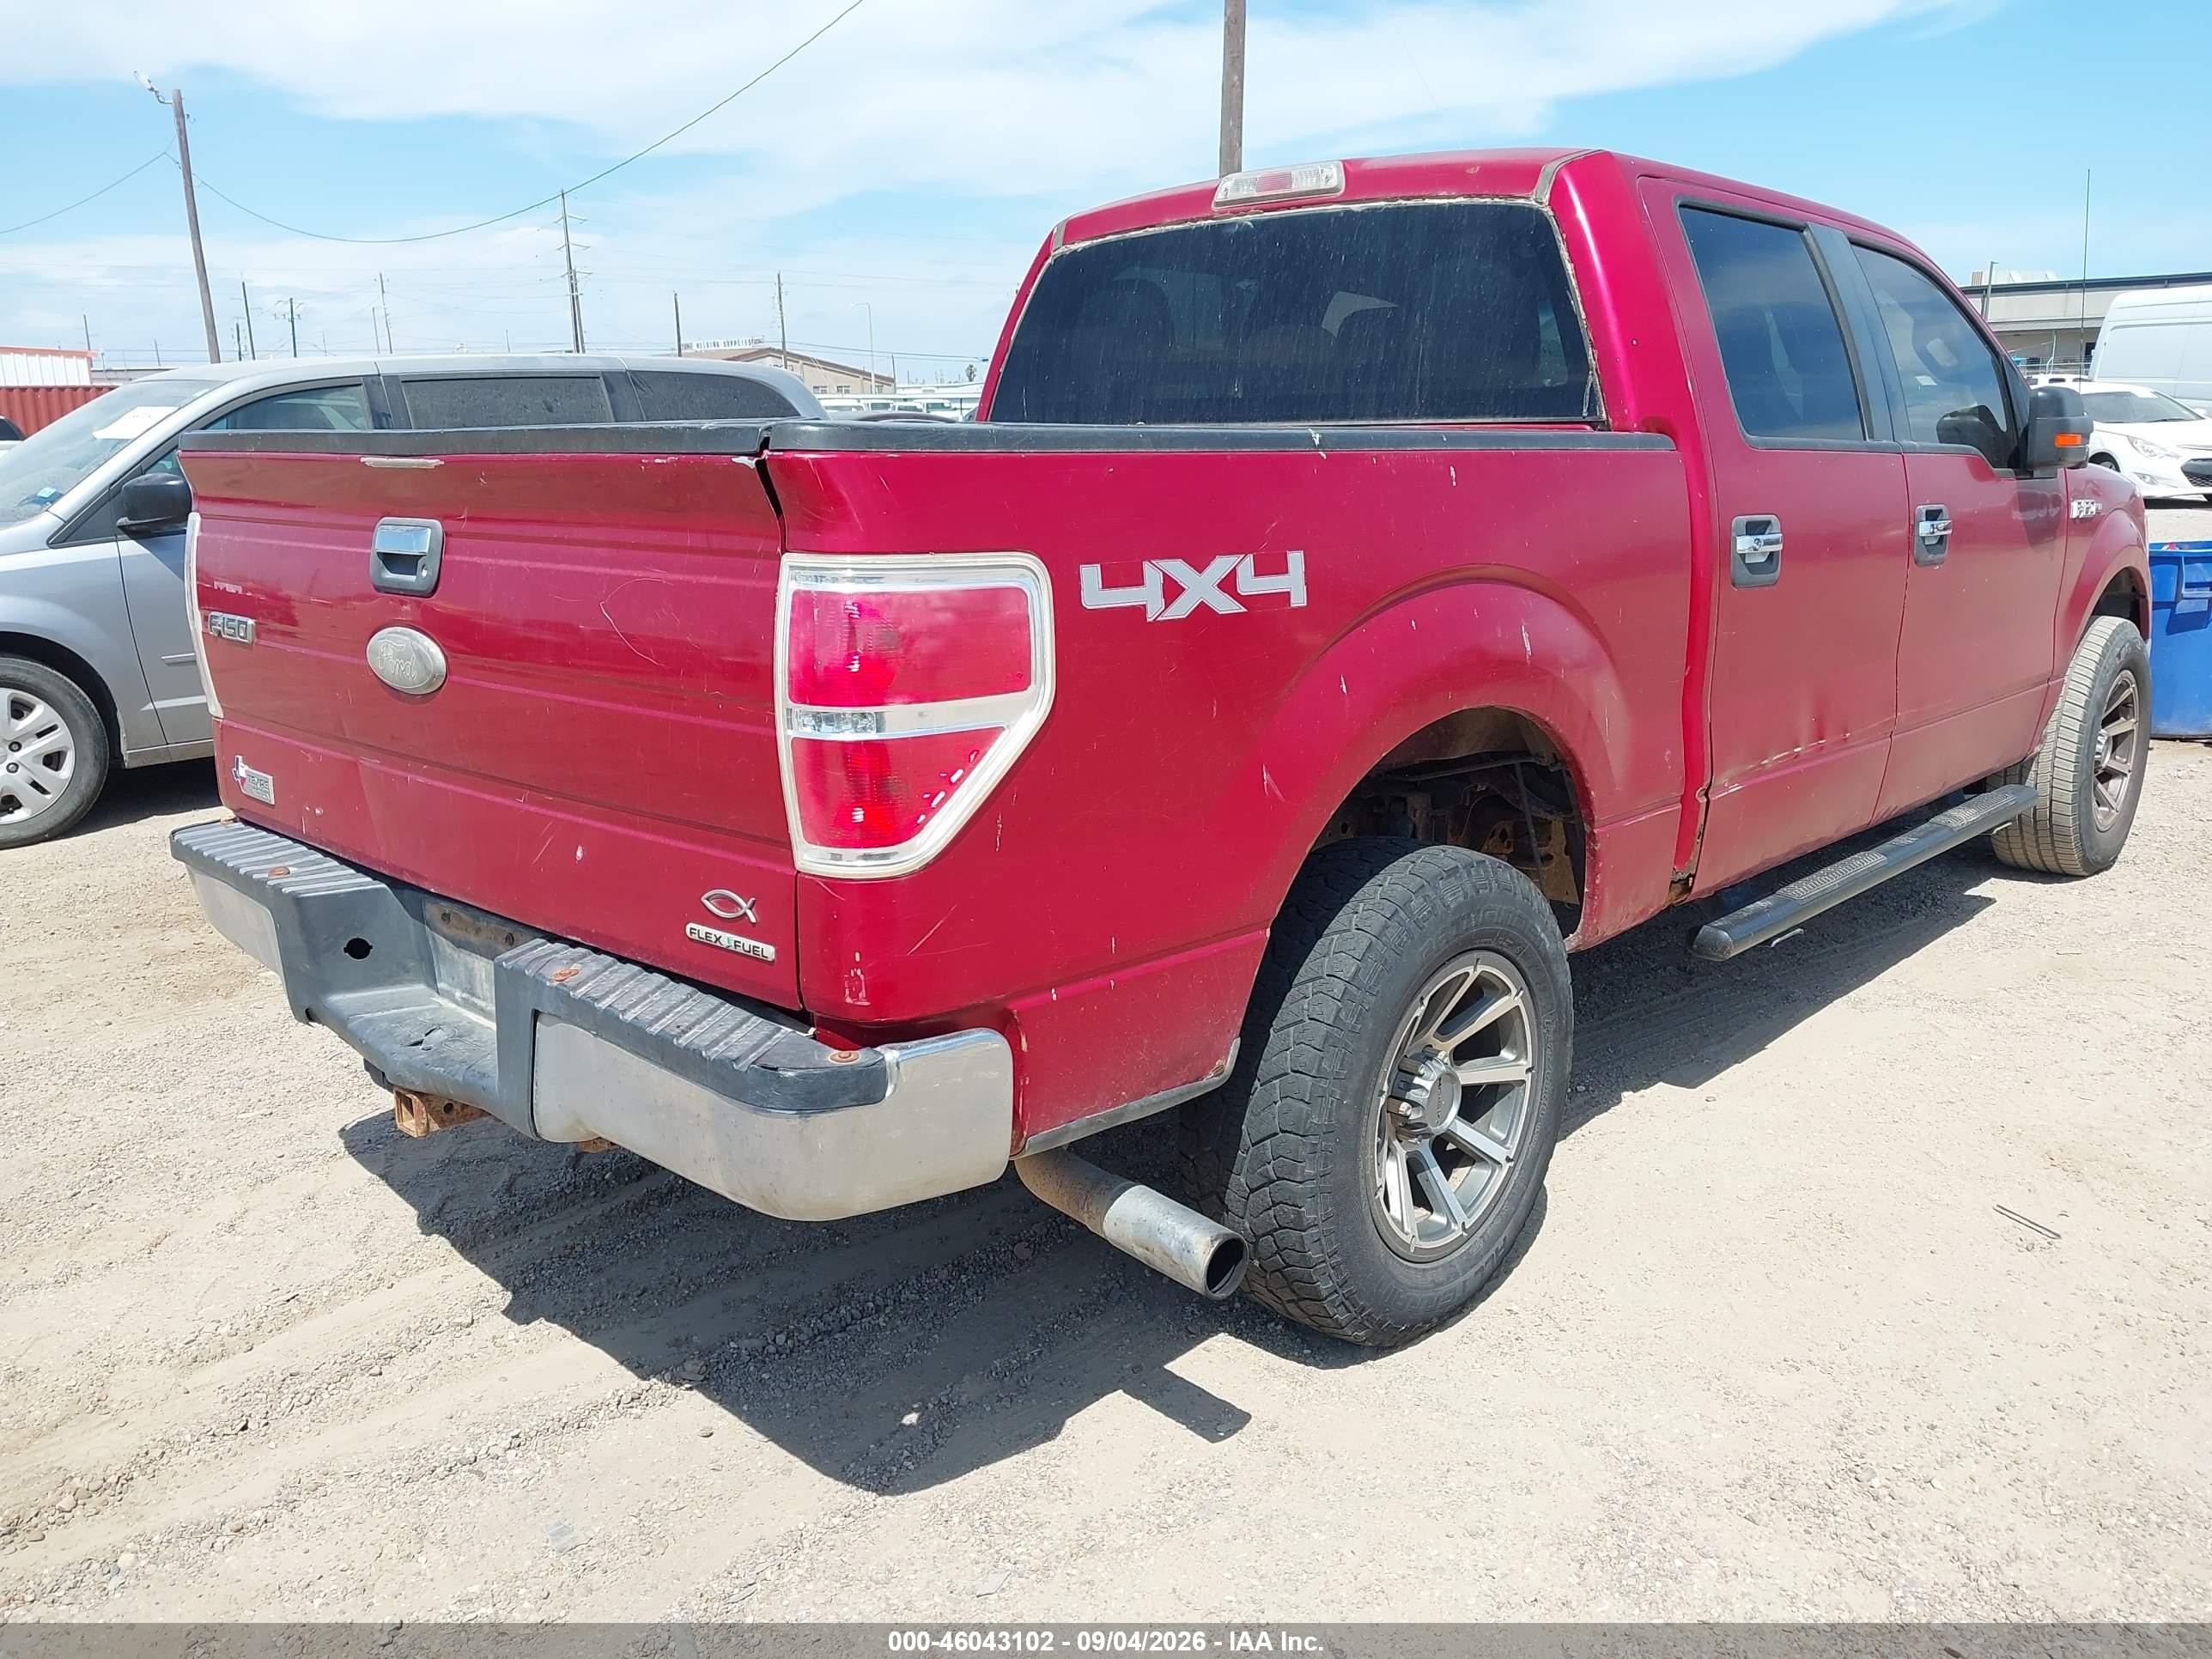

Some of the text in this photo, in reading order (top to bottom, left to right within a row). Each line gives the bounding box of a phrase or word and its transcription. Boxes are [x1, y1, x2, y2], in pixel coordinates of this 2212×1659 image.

[1079, 550, 1307, 623] 4X4
[377, 639, 417, 681] Ford
[689, 927, 769, 959] FLEX FUEL
